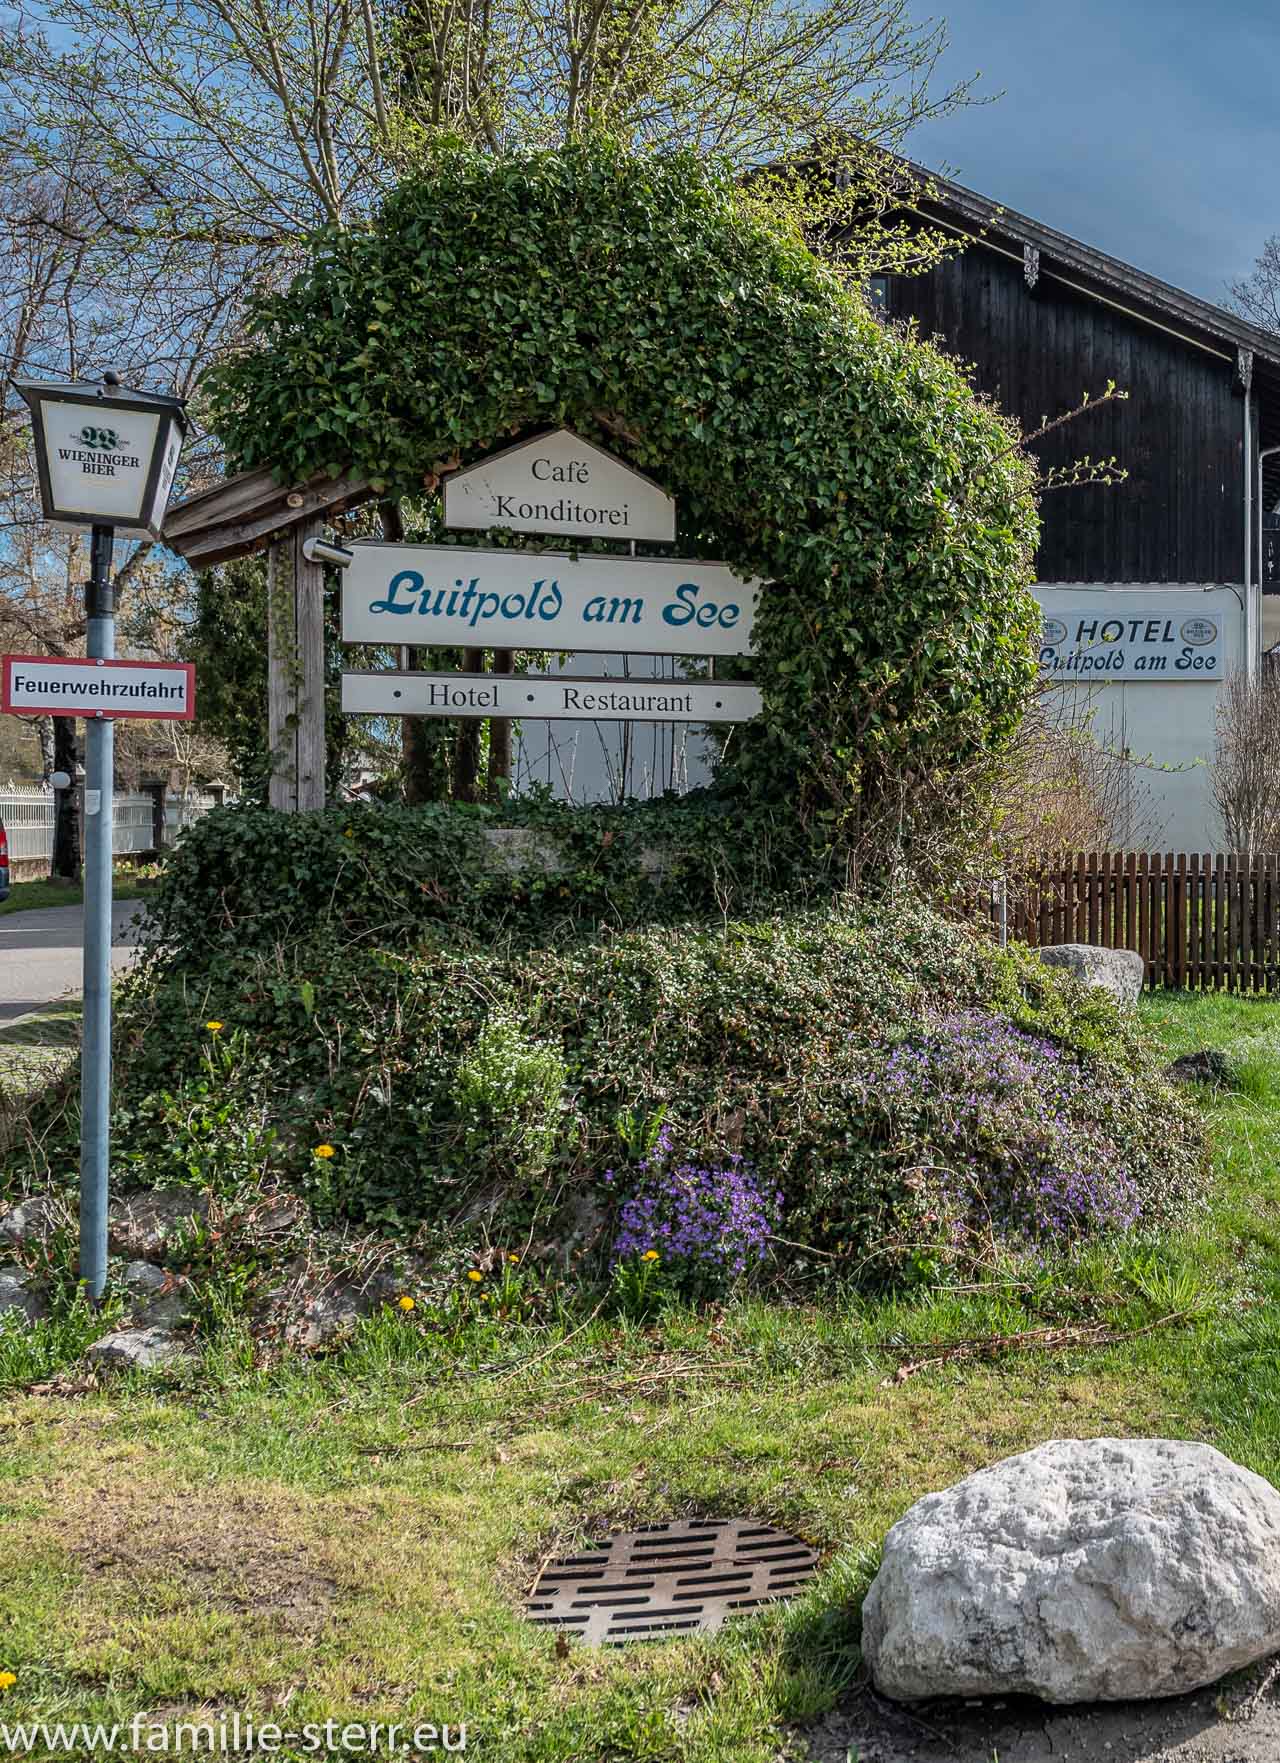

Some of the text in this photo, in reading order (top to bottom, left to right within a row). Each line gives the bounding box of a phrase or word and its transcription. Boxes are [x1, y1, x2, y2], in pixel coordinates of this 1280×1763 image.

[58, 448, 140, 468] WIENINGER
[82, 462, 115, 476] BIER
[531, 458, 590, 485] Café
[496, 495, 630, 526] Konditorei
[368, 570, 741, 629] Luitpold am See
[1075, 620, 1175, 643] HOTEL
[1134, 655, 1167, 670] am
[1174, 647, 1217, 670] See
[14, 676, 185, 699] Feuerwehrzufahrt
[428, 684, 693, 711] Hotel Restaurant
